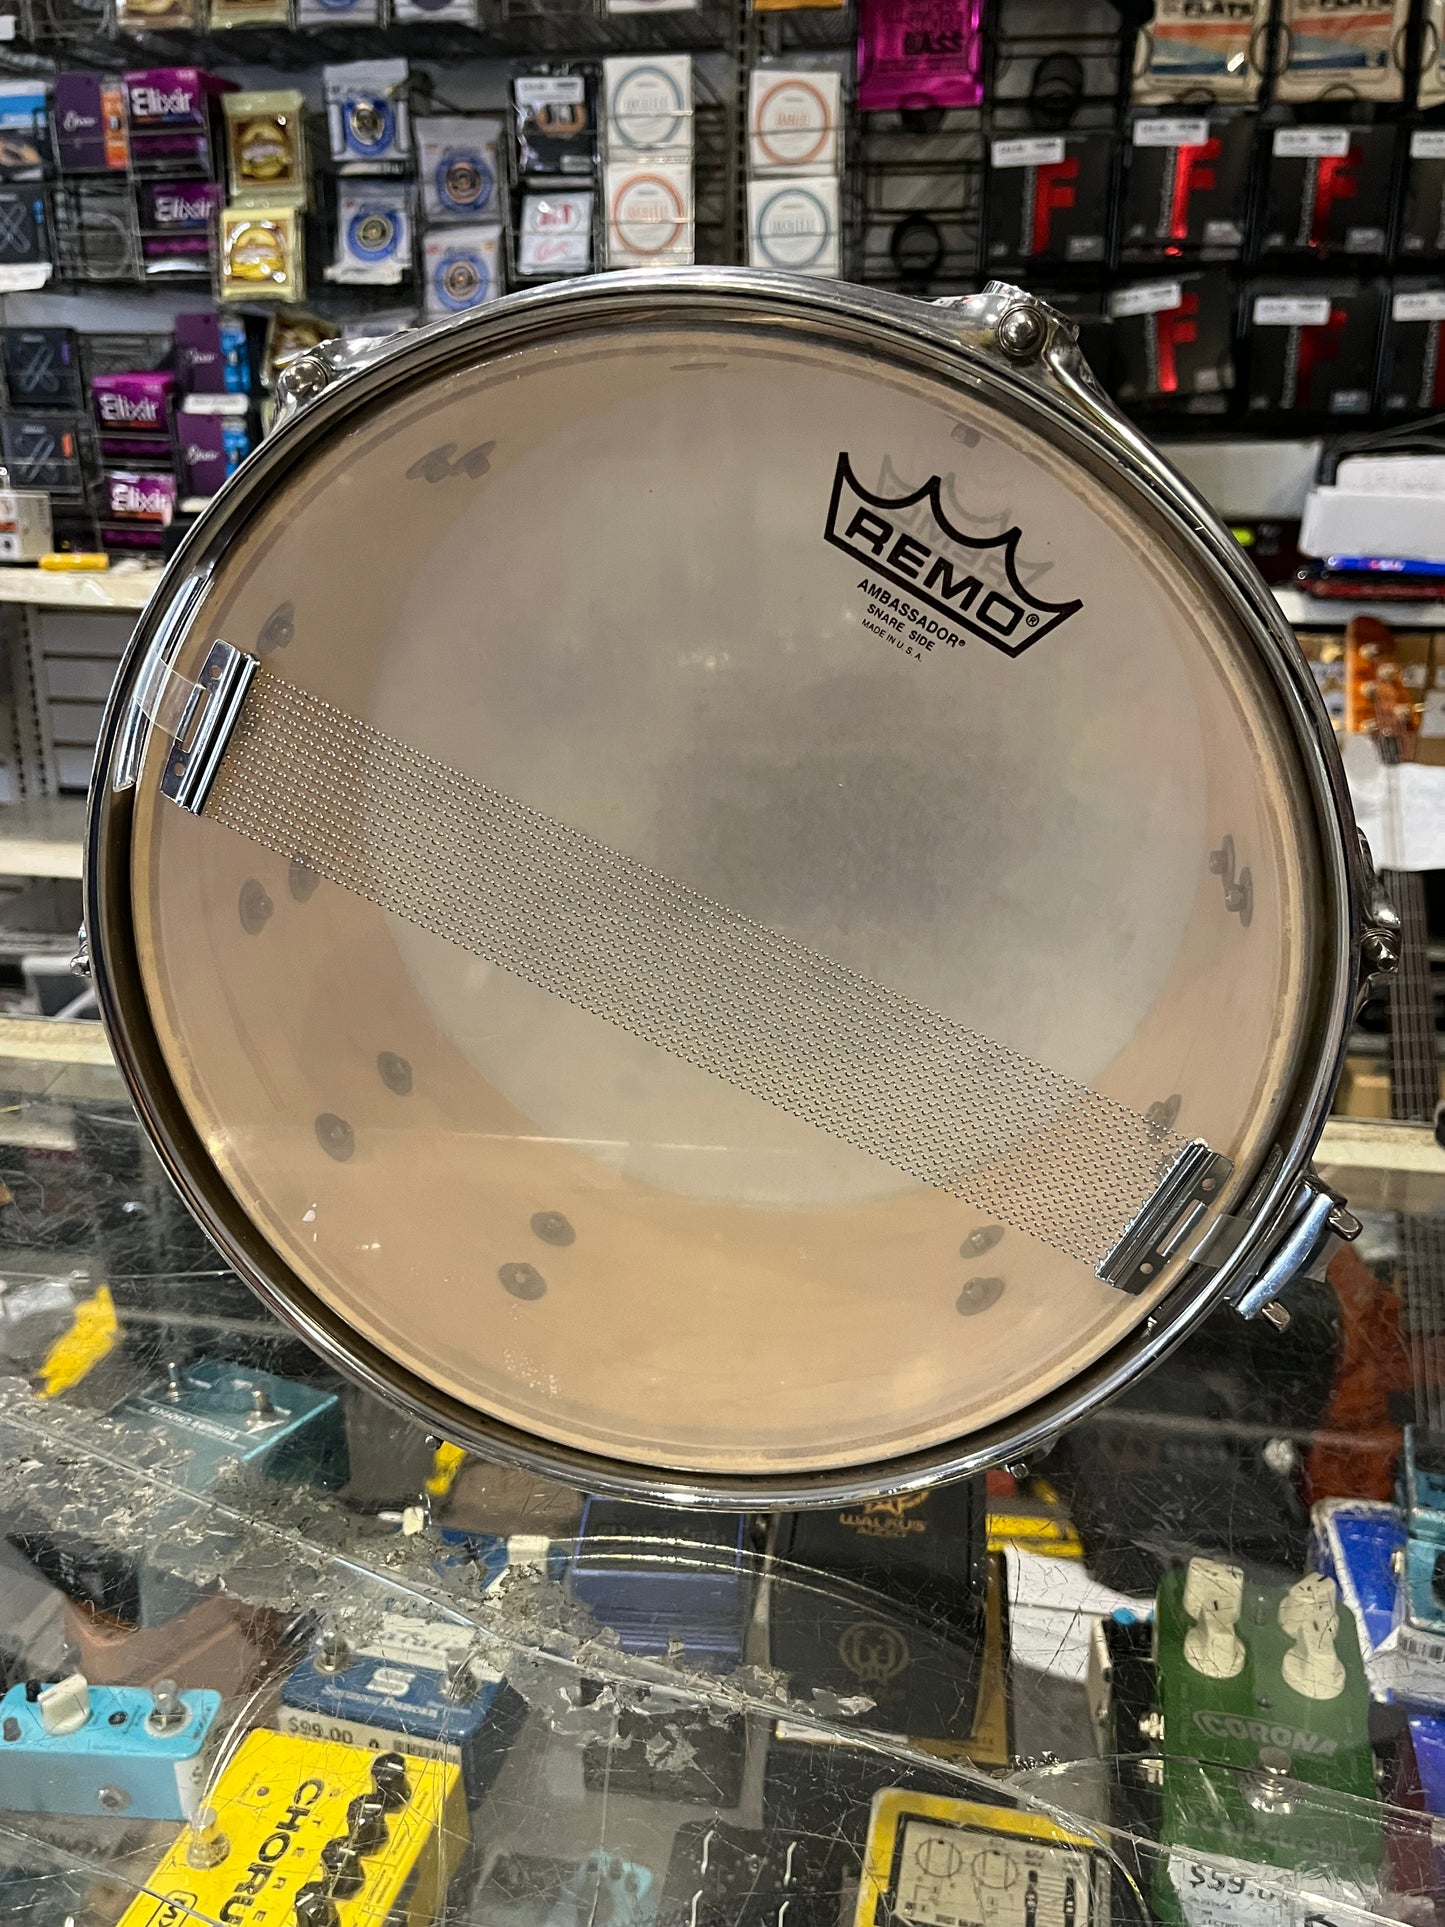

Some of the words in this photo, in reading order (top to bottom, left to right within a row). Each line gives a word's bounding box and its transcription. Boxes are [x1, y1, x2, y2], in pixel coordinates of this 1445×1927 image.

[130, 87, 193, 115] Elixir
[155, 195, 214, 222] Elixir
[100, 393, 160, 421] Elixir
[111, 484, 171, 512] Elixir
[861, 618, 887, 638] MADE
[886, 633, 897, 645] IN
[867, 604, 906, 632] SNARE
[908, 630, 936, 652] SIDE
[287, 1714, 354, 1744] $99.00
[1200, 1714, 1338, 1758] CORONA
